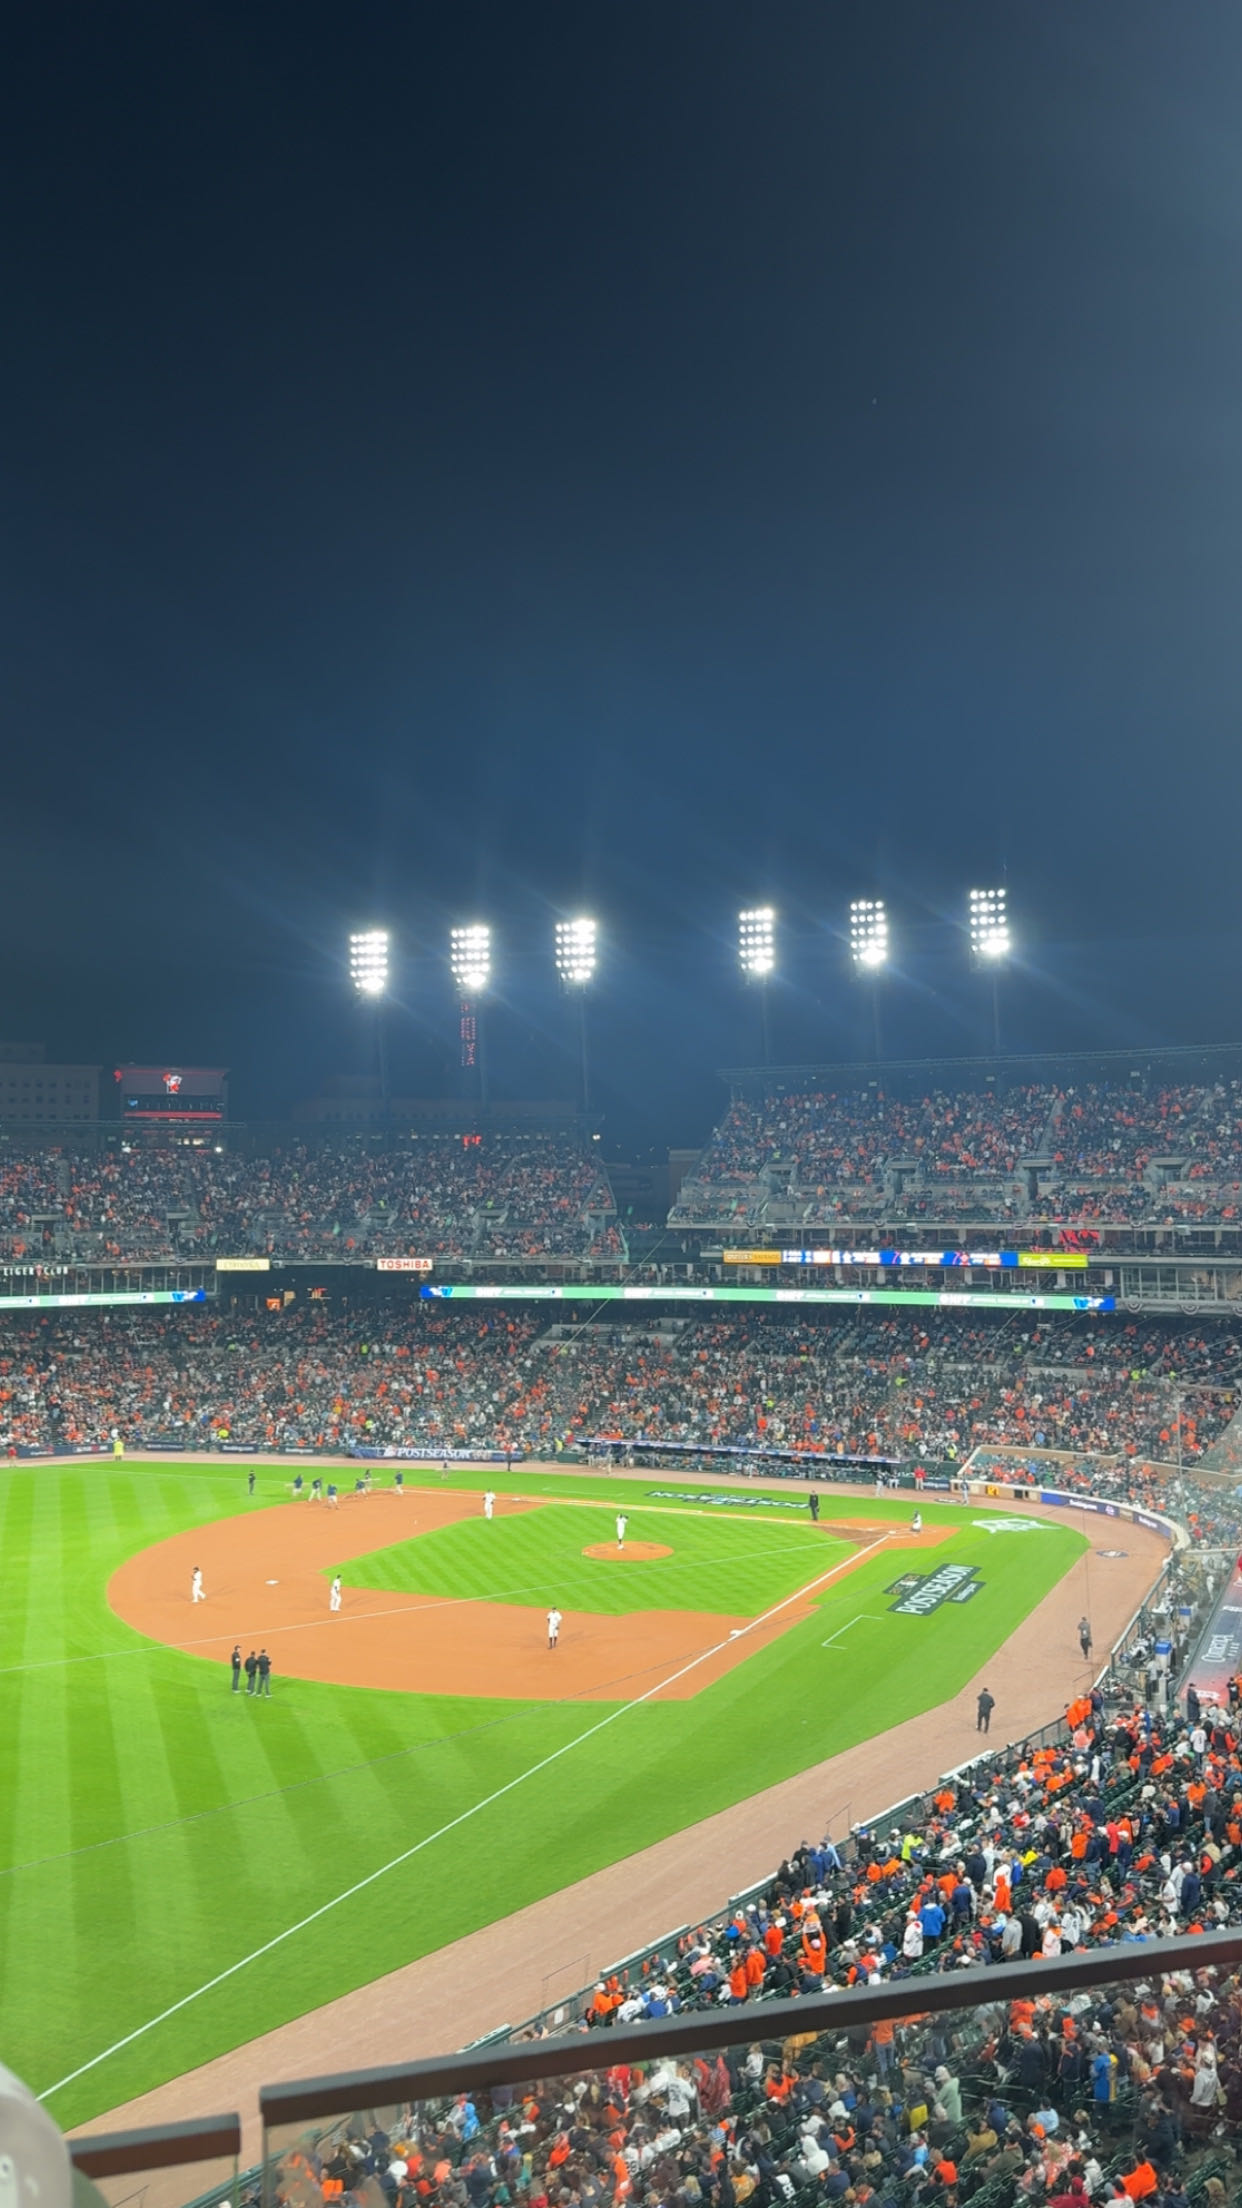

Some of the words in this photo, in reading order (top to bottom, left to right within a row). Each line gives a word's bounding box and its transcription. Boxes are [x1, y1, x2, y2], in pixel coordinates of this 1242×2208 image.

[380, 1260, 430, 1269] TOSHIBA
[3, 1267, 34, 1276] TIGER
[44, 1266, 69, 1276] CLUB
[397, 1447, 471, 1460] POSTSEASON
[895, 1564, 974, 1615] POSTSEASON
